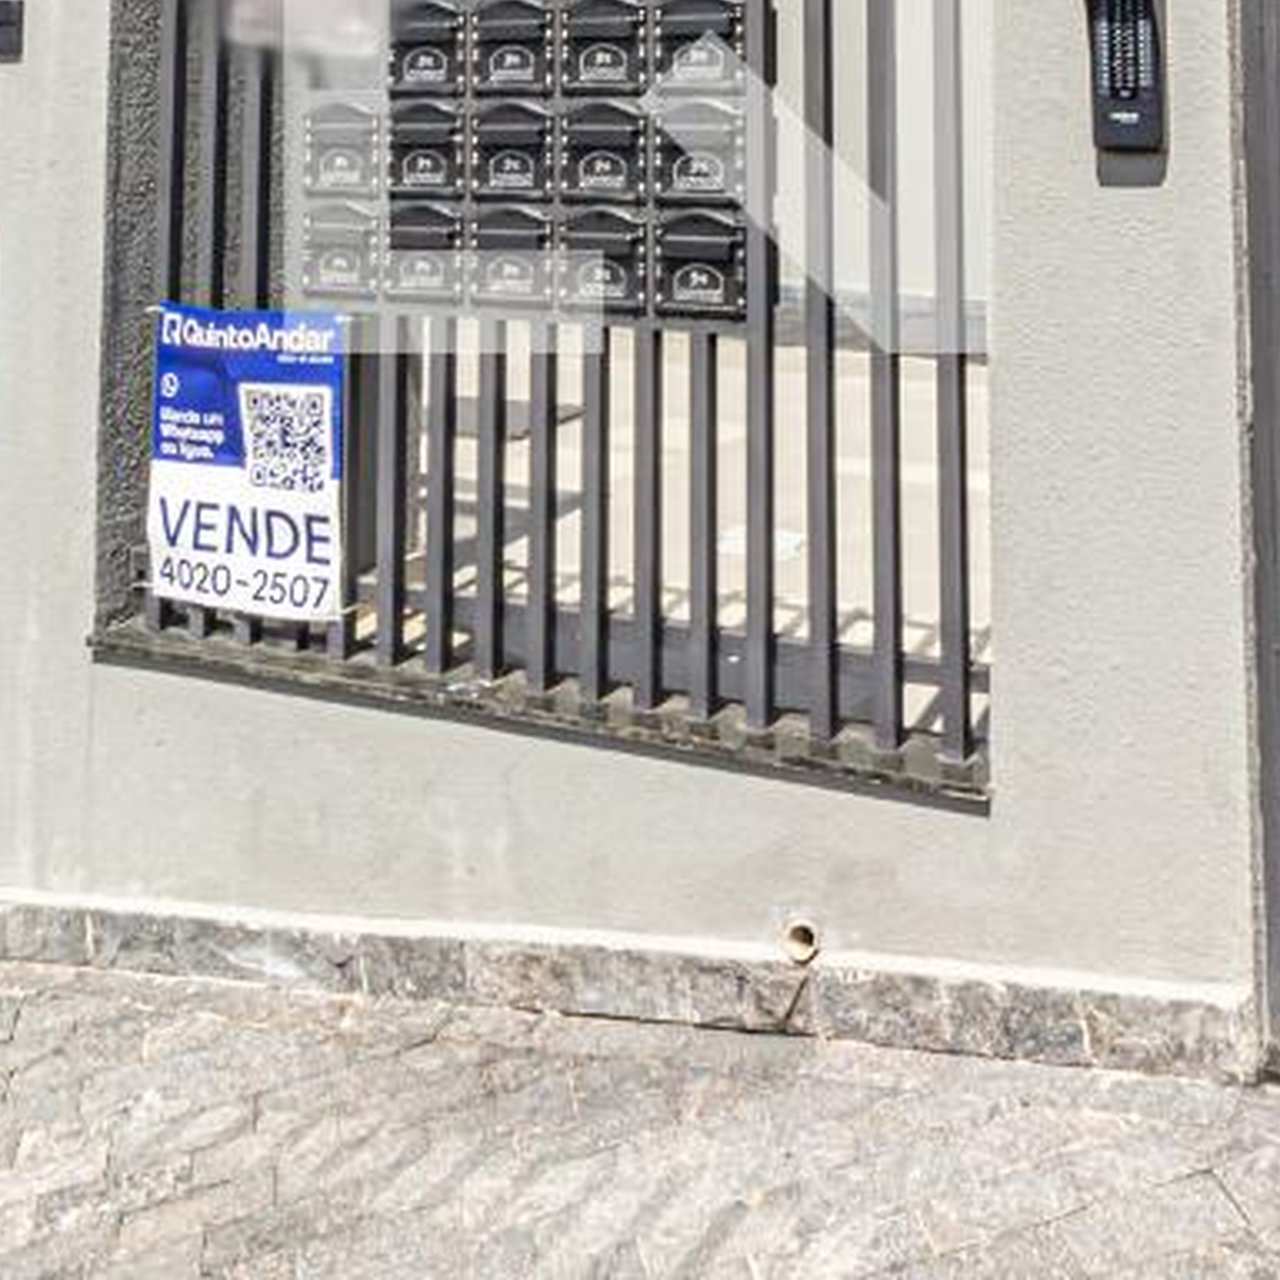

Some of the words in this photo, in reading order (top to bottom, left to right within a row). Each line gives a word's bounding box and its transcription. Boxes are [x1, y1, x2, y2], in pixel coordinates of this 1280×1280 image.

[183, 319, 335, 352] QuintoAndar
[160, 497, 331, 565] VENDE
[160, 557, 331, 609] 4020-2507
